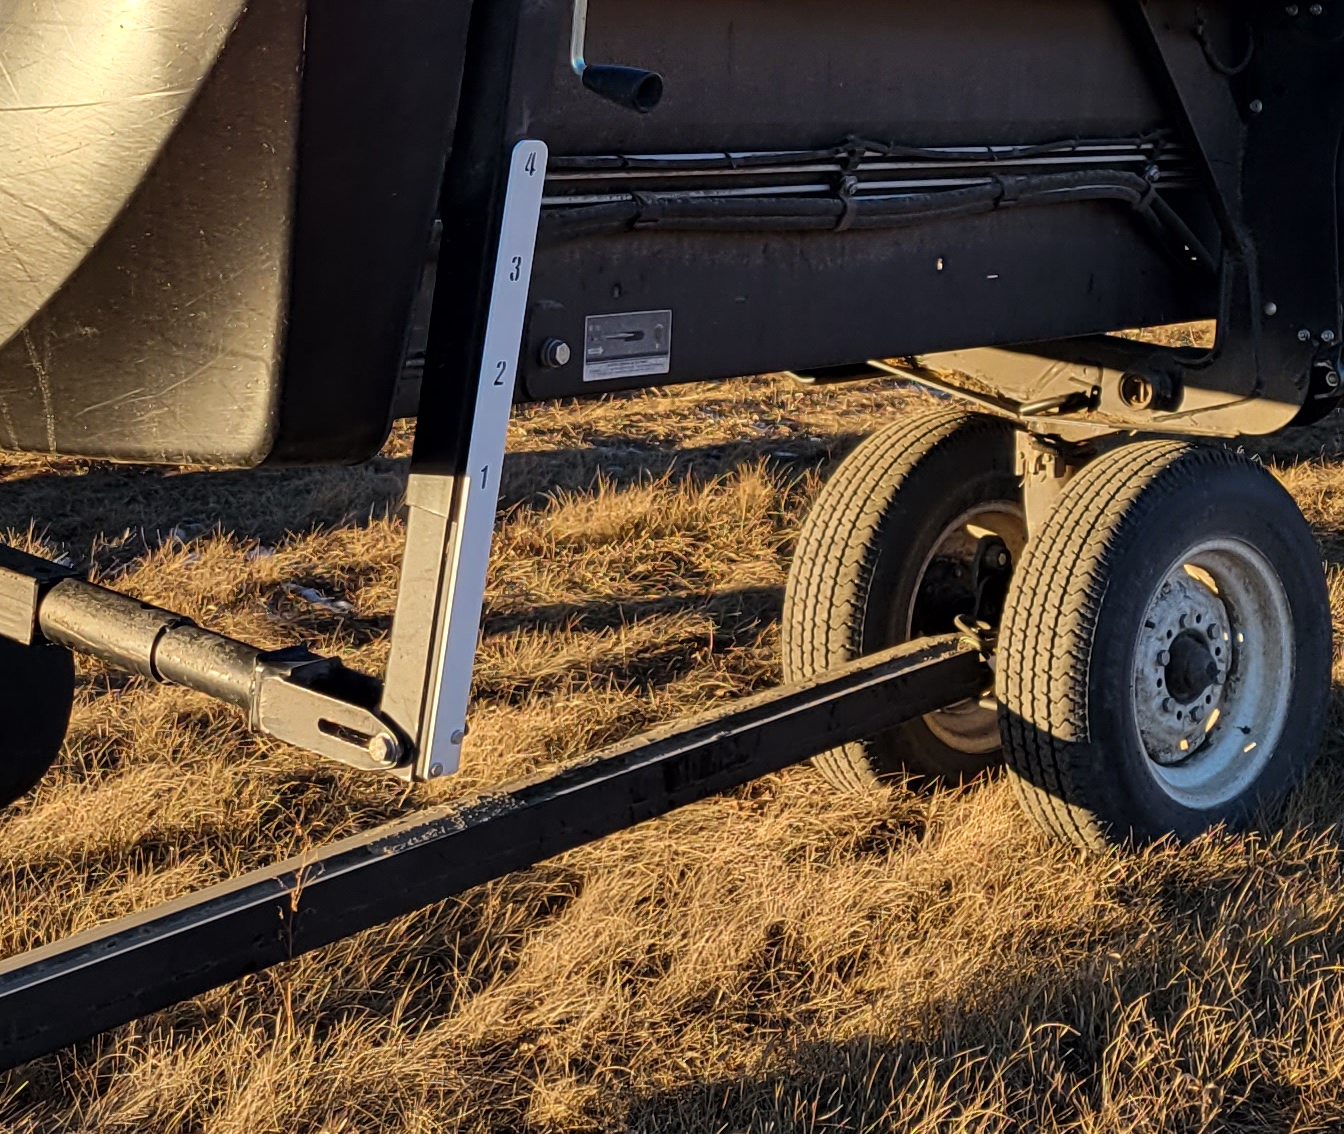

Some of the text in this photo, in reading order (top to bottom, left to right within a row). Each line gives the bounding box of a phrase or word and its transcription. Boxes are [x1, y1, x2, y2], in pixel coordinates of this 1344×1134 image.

[524, 151, 537, 176] 4
[509, 255, 522, 281] 3
[493, 360, 507, 386] 2
[480, 464, 489, 490] 1
